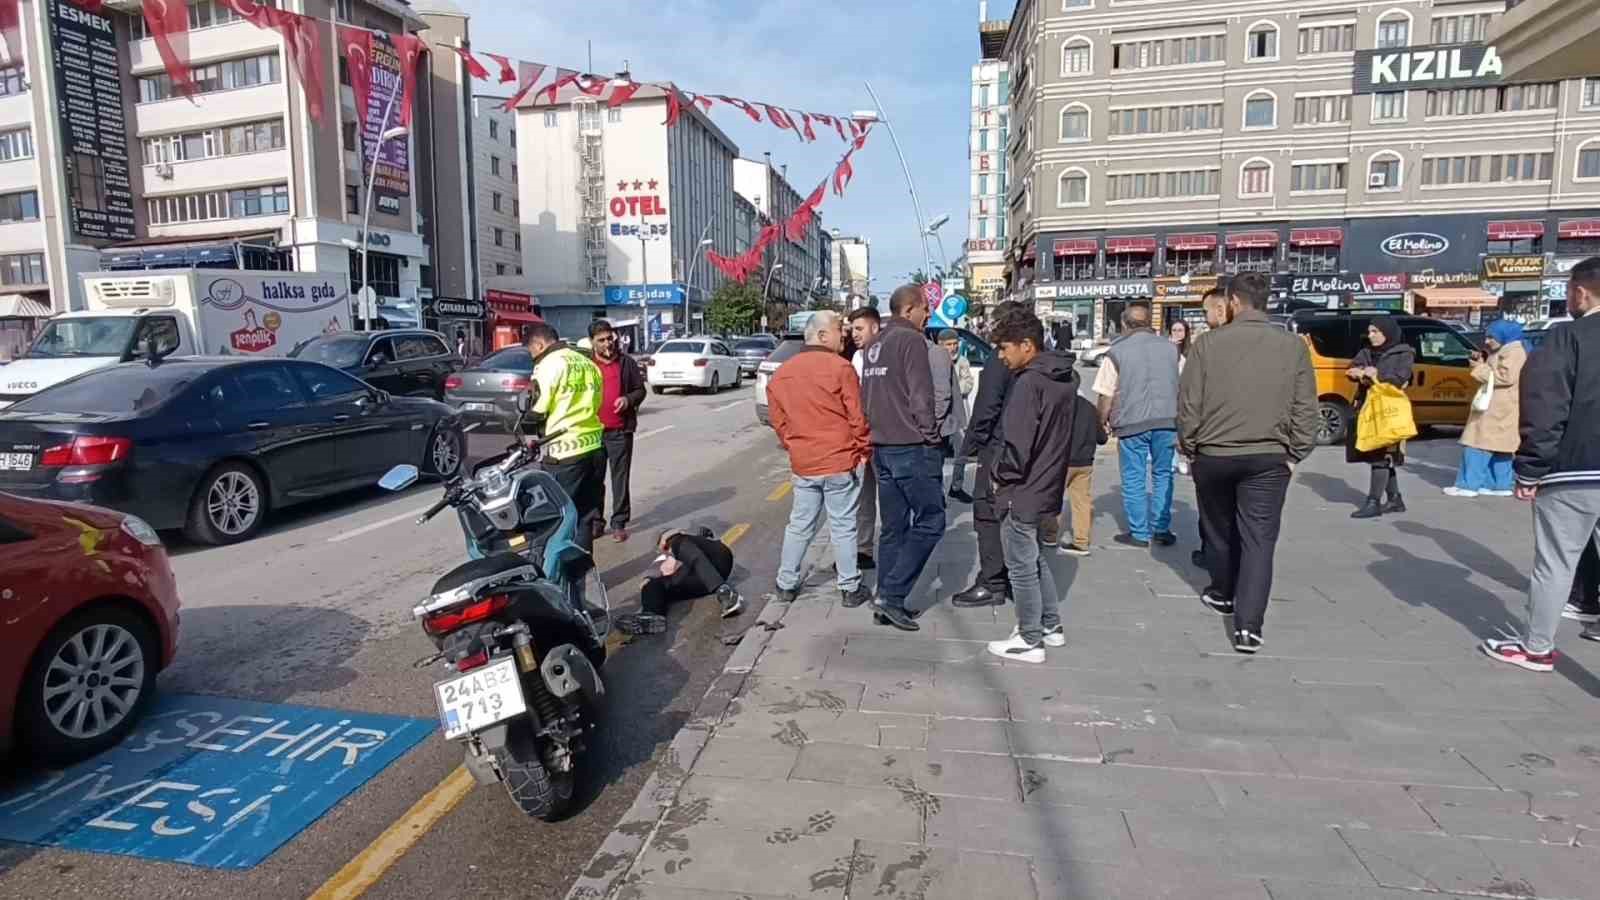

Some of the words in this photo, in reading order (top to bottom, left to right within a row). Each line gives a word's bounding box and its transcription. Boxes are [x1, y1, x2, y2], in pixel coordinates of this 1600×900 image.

[58, 3, 113, 34] ESMEK
[609, 195, 667, 217] OTEL
[1388, 239, 1402, 250] El
[1403, 238, 1442, 250] Molino
[262, 281, 305, 300] halksa
[311, 281, 336, 303] gıda
[1058, 285, 1117, 298] MUAMMER
[1119, 282, 1149, 295] USTA
[1292, 278, 1309, 292] El
[1311, 277, 1361, 292] Molino
[462, 692, 503, 720] 713
